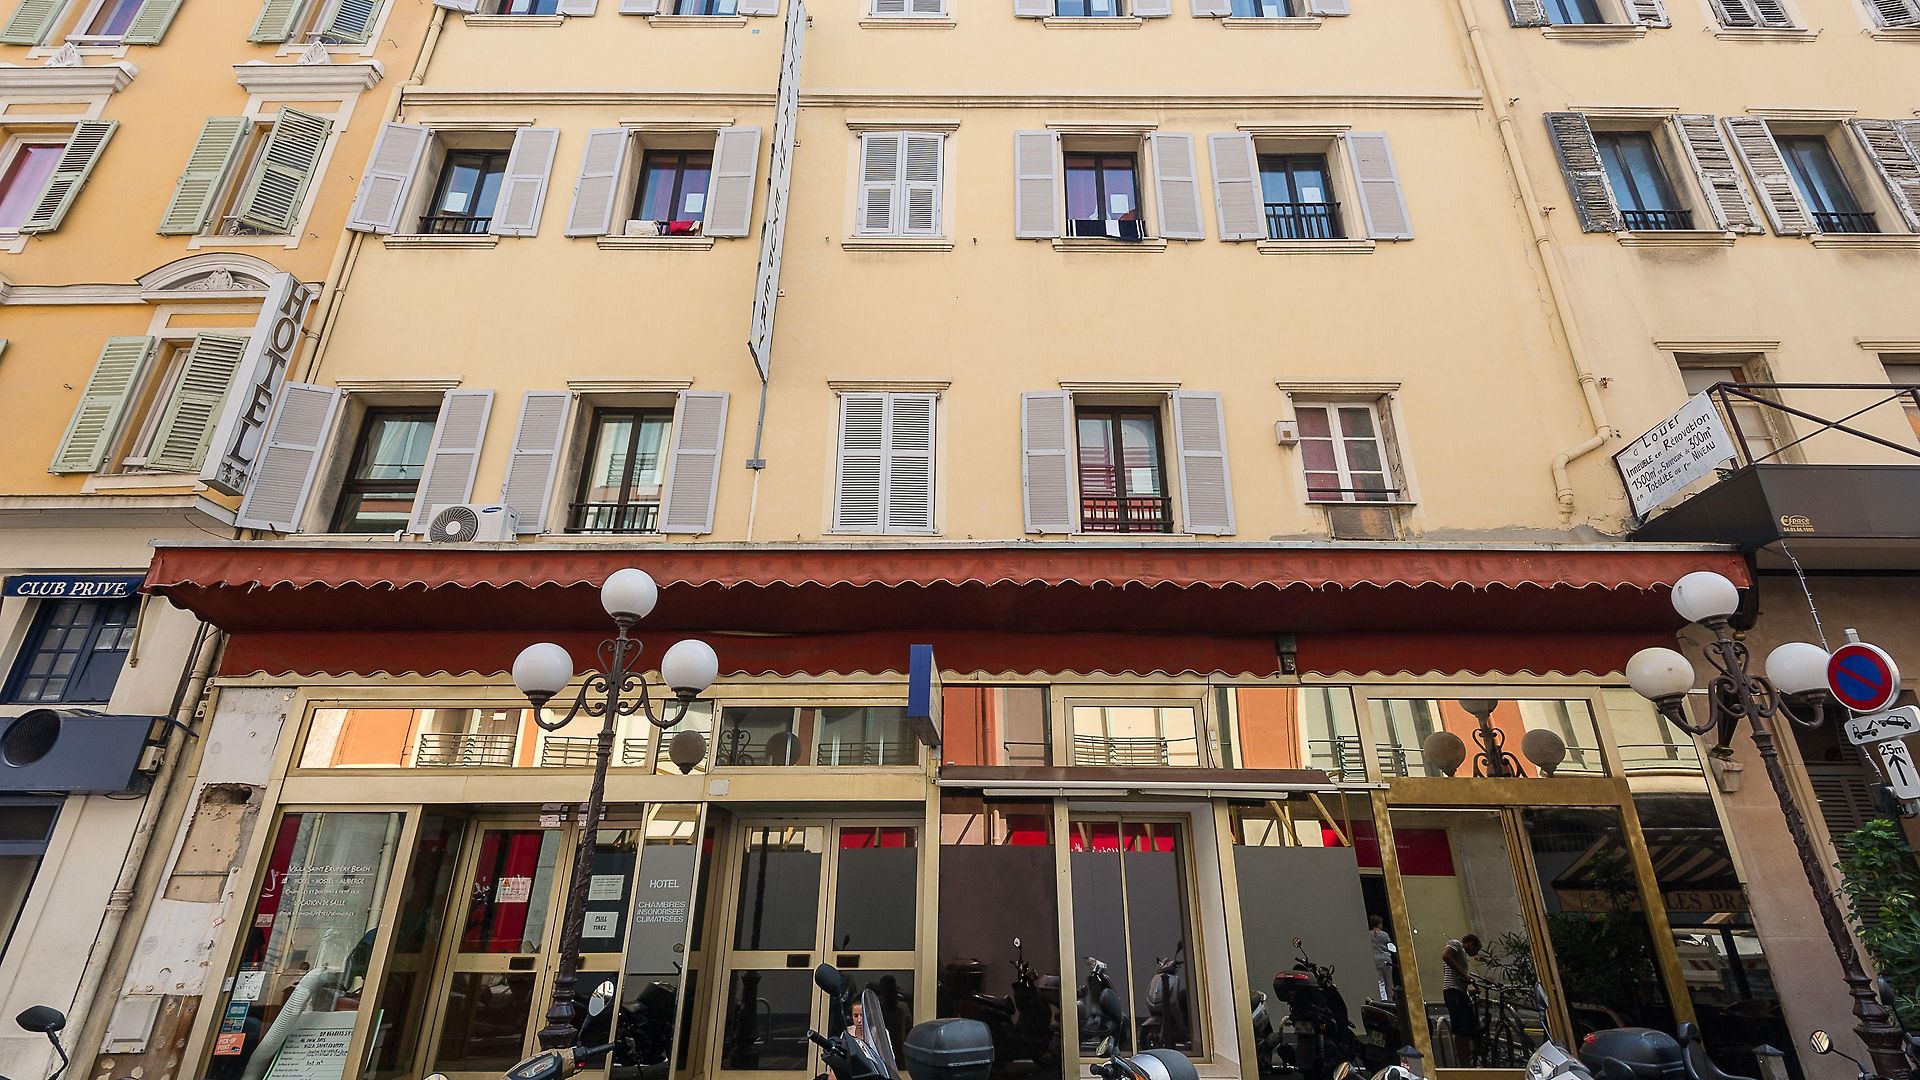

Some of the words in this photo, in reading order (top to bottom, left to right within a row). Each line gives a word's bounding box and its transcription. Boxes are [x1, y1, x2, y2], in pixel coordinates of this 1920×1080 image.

[228, 279, 312, 466] HOTEL
[17, 581, 67, 595] CLUB
[69, 581, 128, 595] PRIVE
[1878, 744, 1906, 756] 25m
[649, 879, 680, 889] HOTEL
[636, 915, 684, 923] CLIMATISEES
